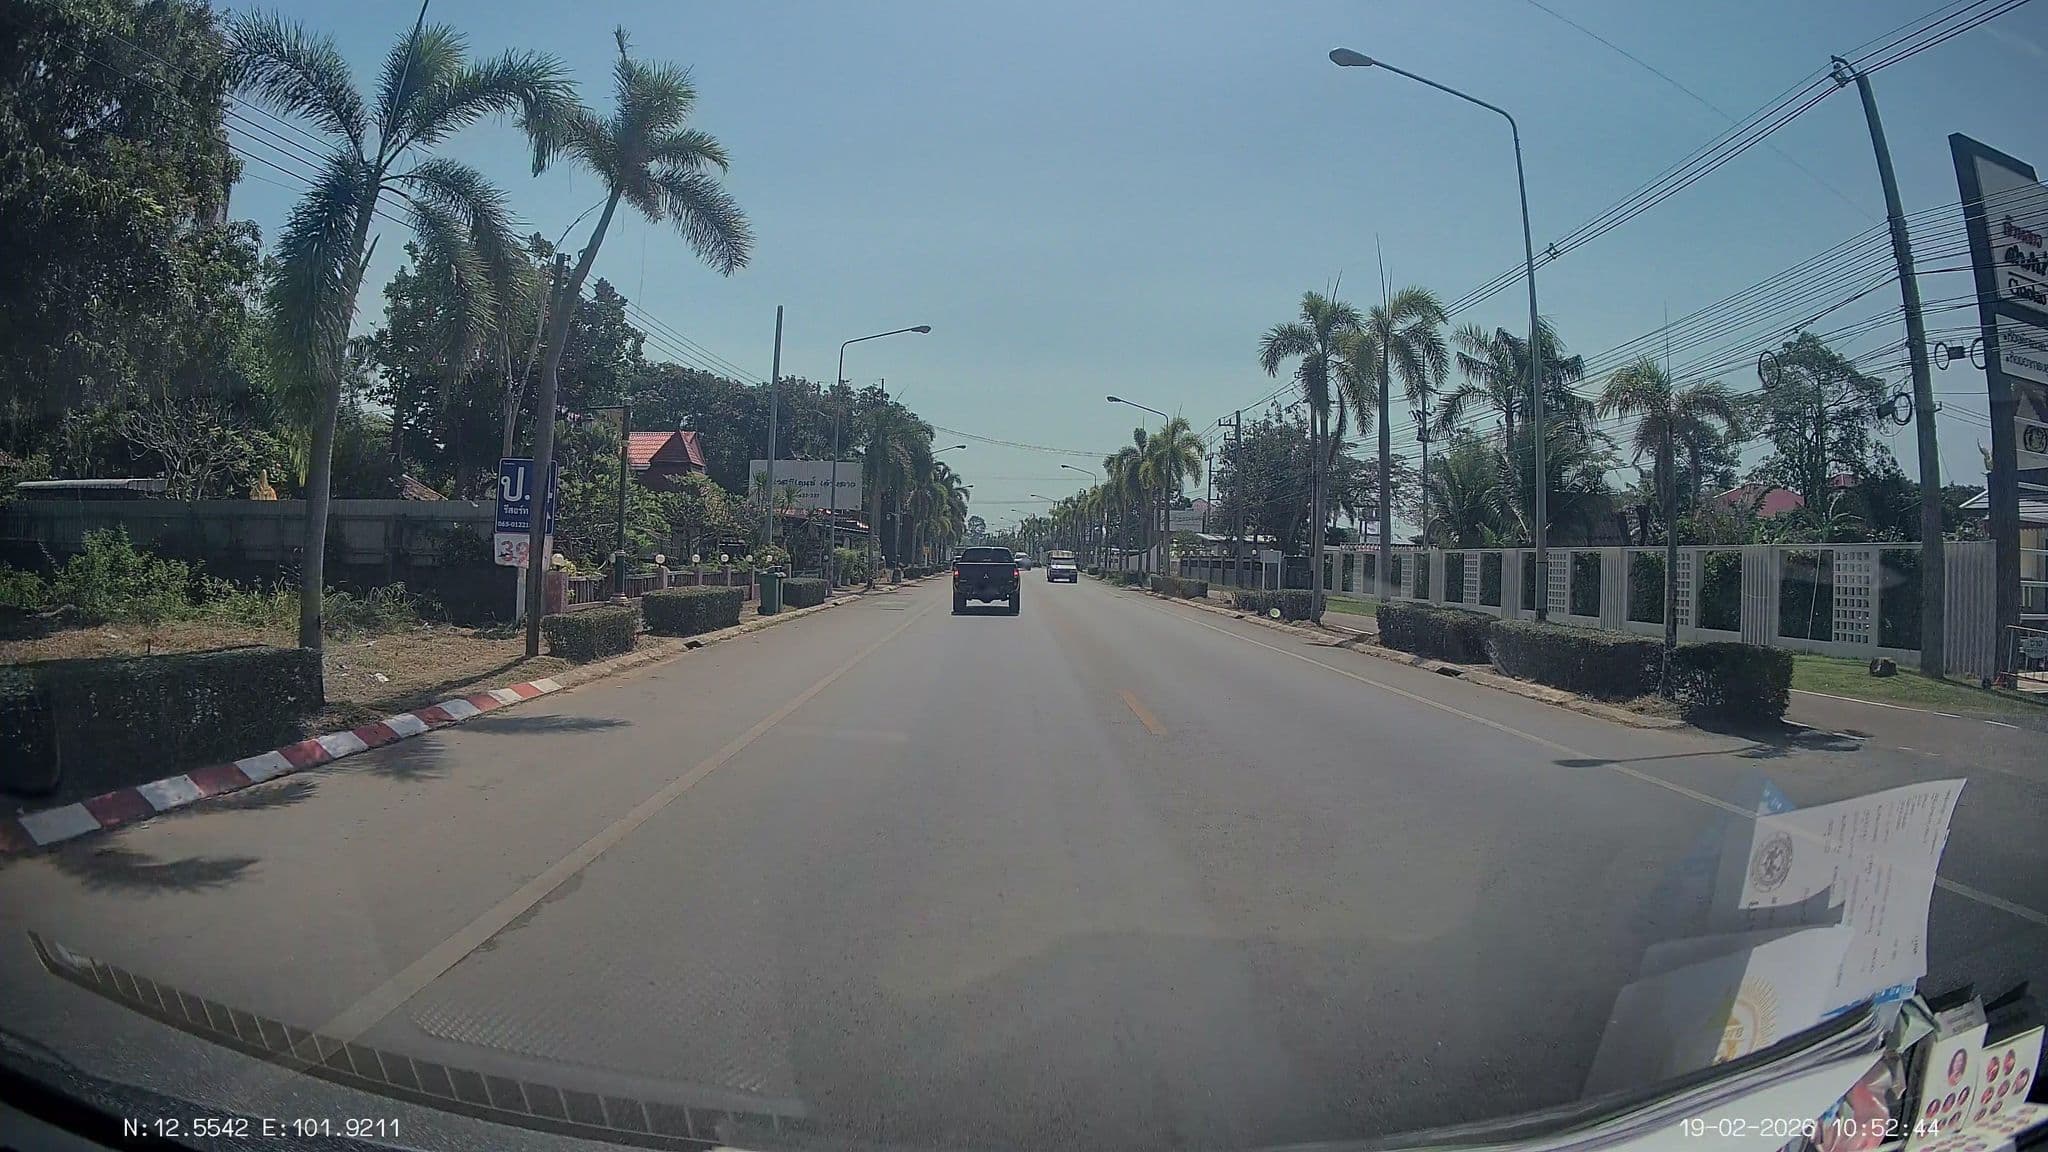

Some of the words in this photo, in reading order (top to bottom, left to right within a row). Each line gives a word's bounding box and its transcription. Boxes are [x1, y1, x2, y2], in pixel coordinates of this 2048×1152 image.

[501, 467, 530, 502] ป.
[504, 504, 529, 515] รีสอร์ท
